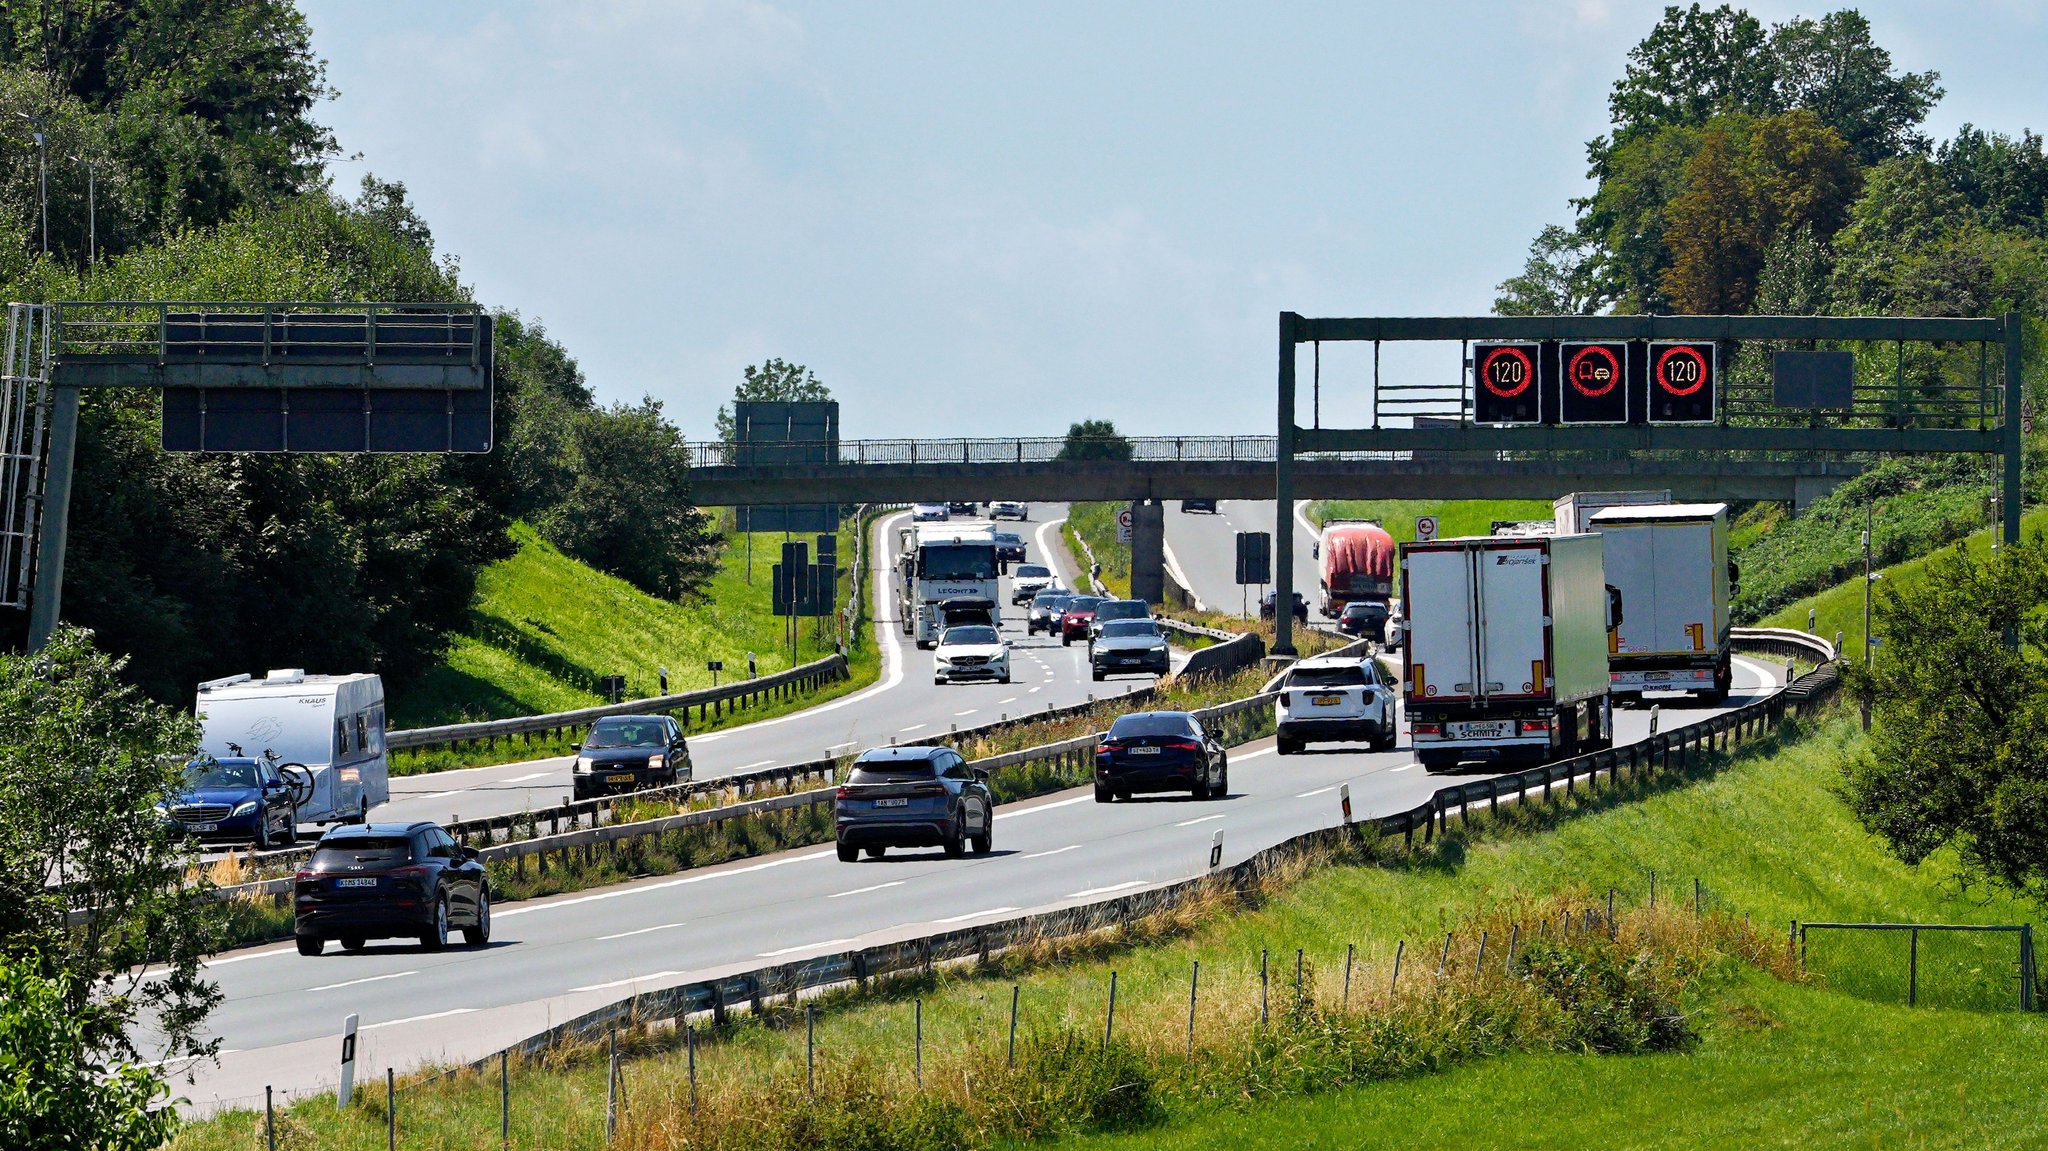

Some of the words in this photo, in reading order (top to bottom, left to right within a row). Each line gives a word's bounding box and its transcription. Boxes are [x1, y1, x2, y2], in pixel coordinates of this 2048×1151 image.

[1492, 361, 1521, 383] 120
[1667, 360, 1697, 382] 120
[1460, 730, 1502, 738] SCHMITZ
